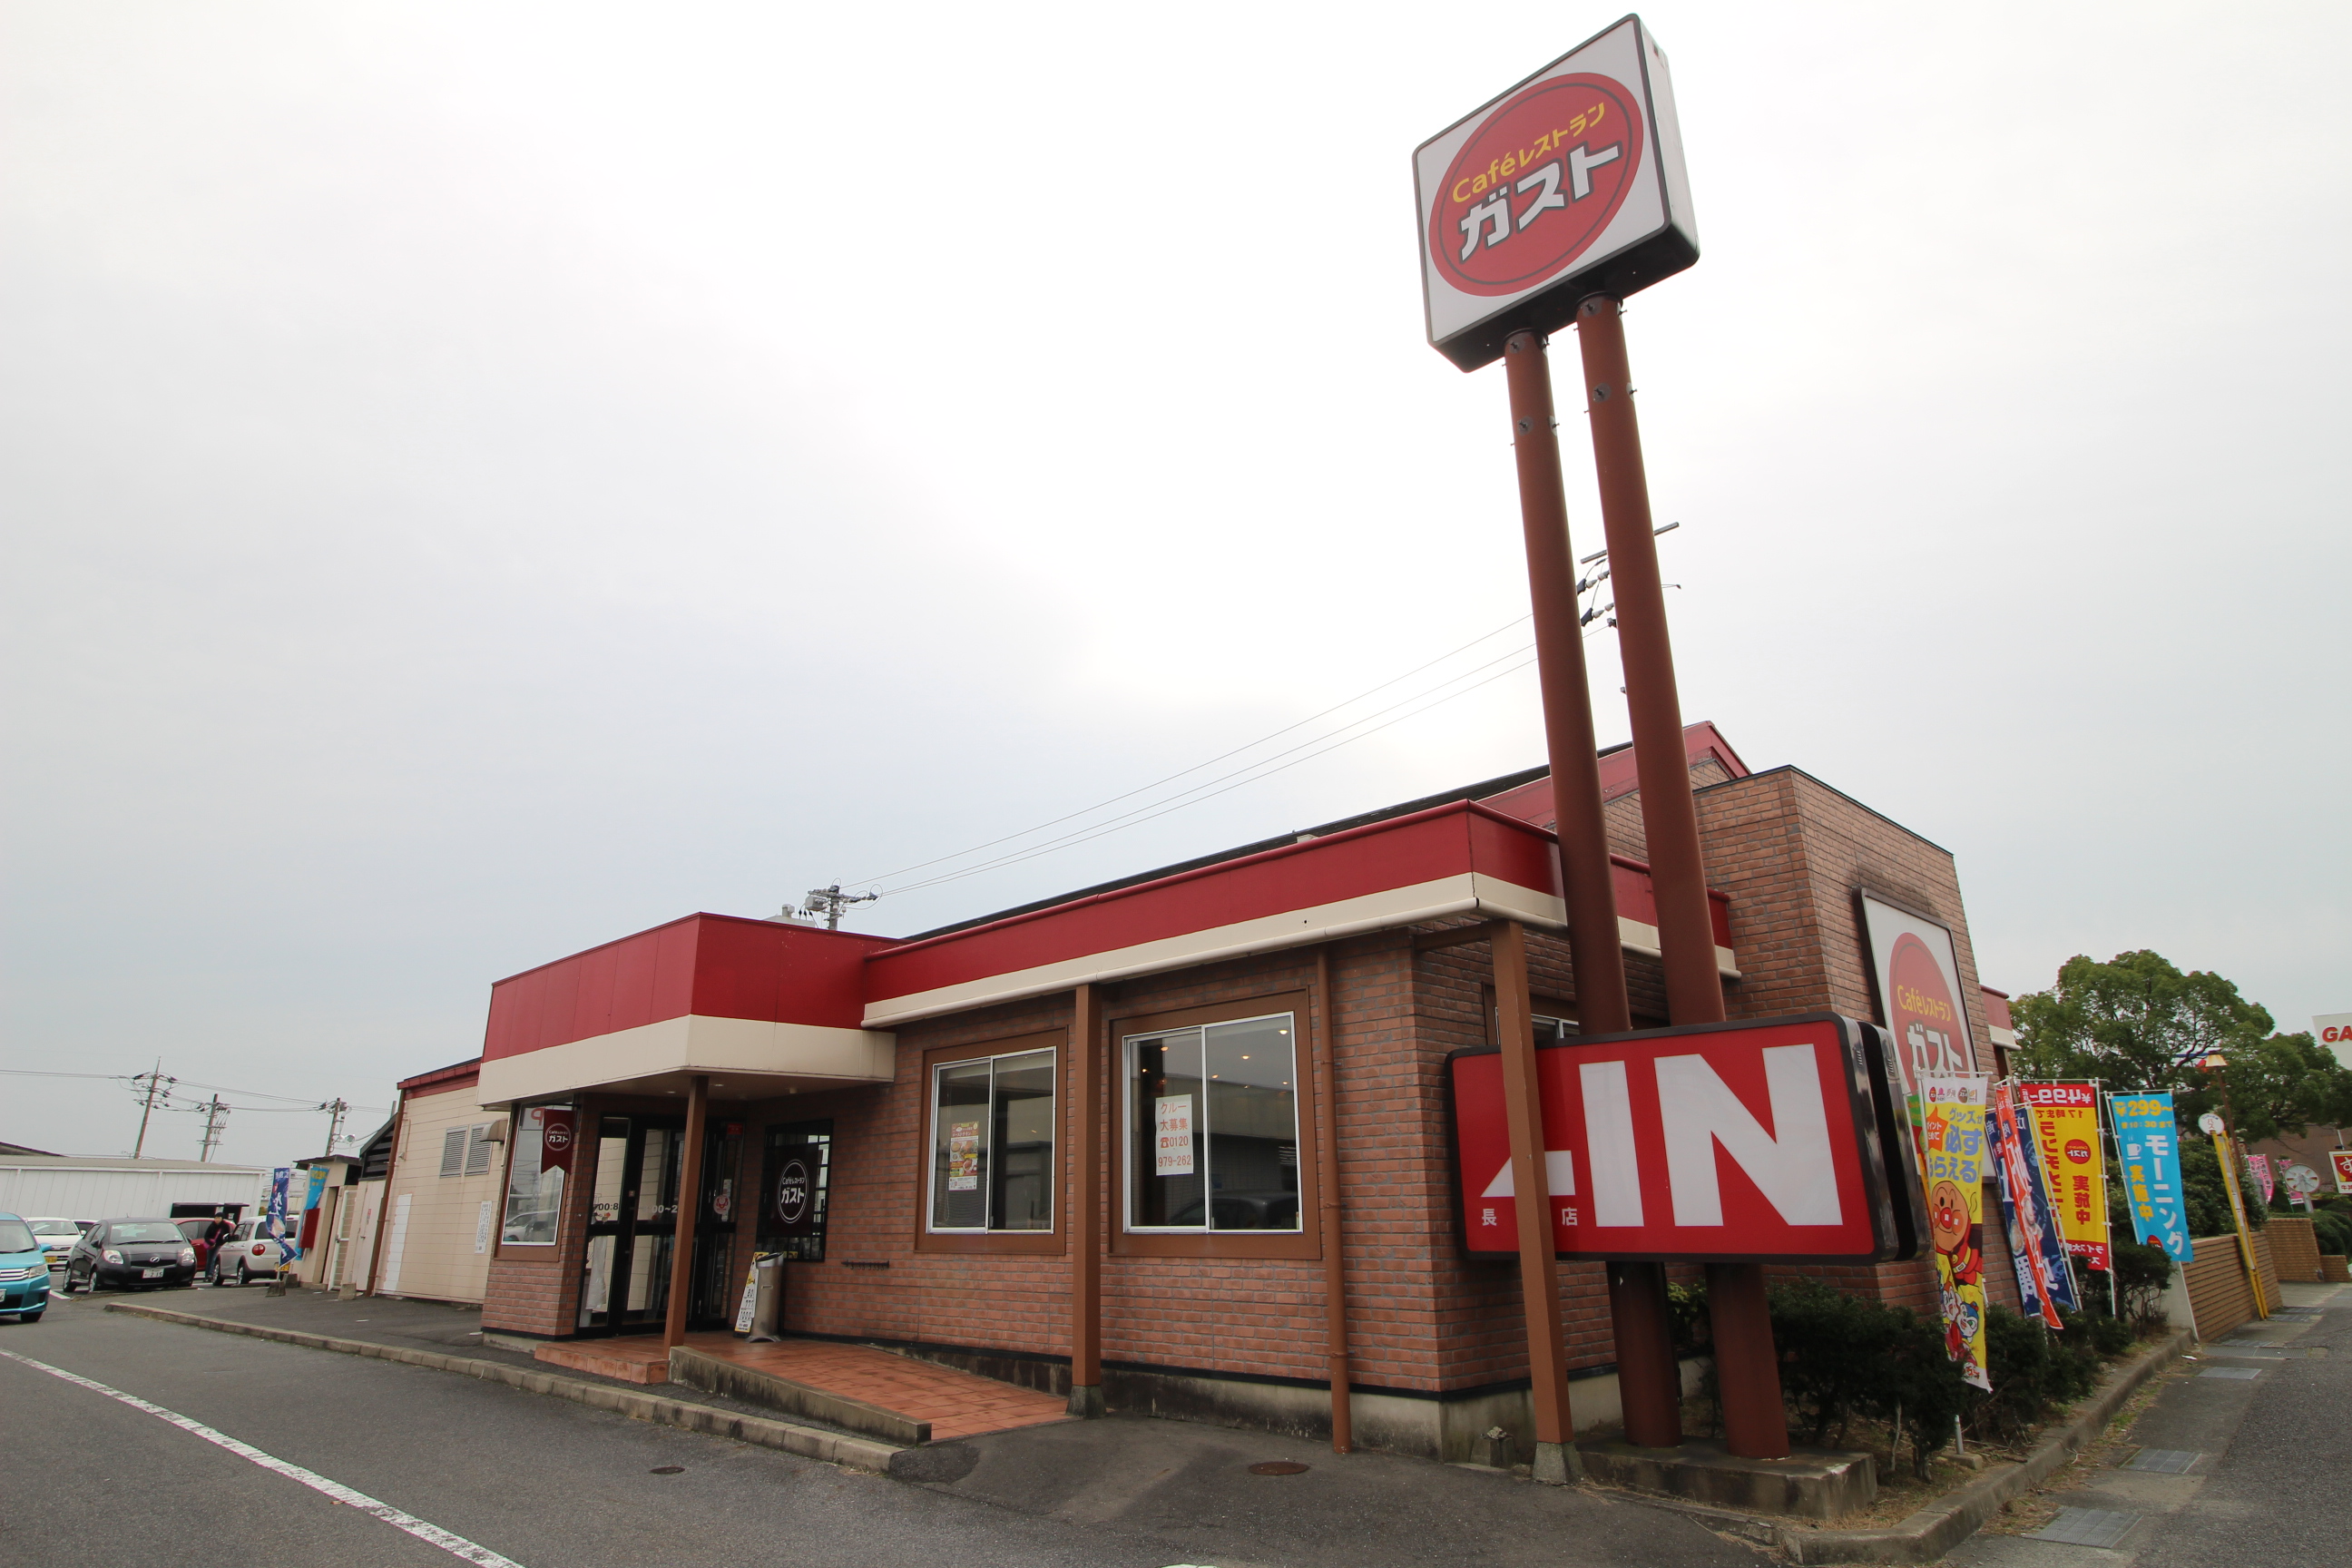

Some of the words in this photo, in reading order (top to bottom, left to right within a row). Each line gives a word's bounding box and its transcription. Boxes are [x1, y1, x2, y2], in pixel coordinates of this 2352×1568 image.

[1452, 102, 1605, 203] Caféレストラン
[1459, 142, 1621, 263] ガスト
[1906, 1023, 1963, 1078] ガスト
[1160, 1117, 1188, 1132] 大募集
[1161, 1102, 1187, 1115] クルー
[548, 1135, 569, 1143] ガスト
[1578, 1044, 1844, 1228] IN
[1158, 1154, 1191, 1168] 979-262
[780, 1187, 805, 1204] ガスト
[2144, 1134, 2184, 1255] モーニング
